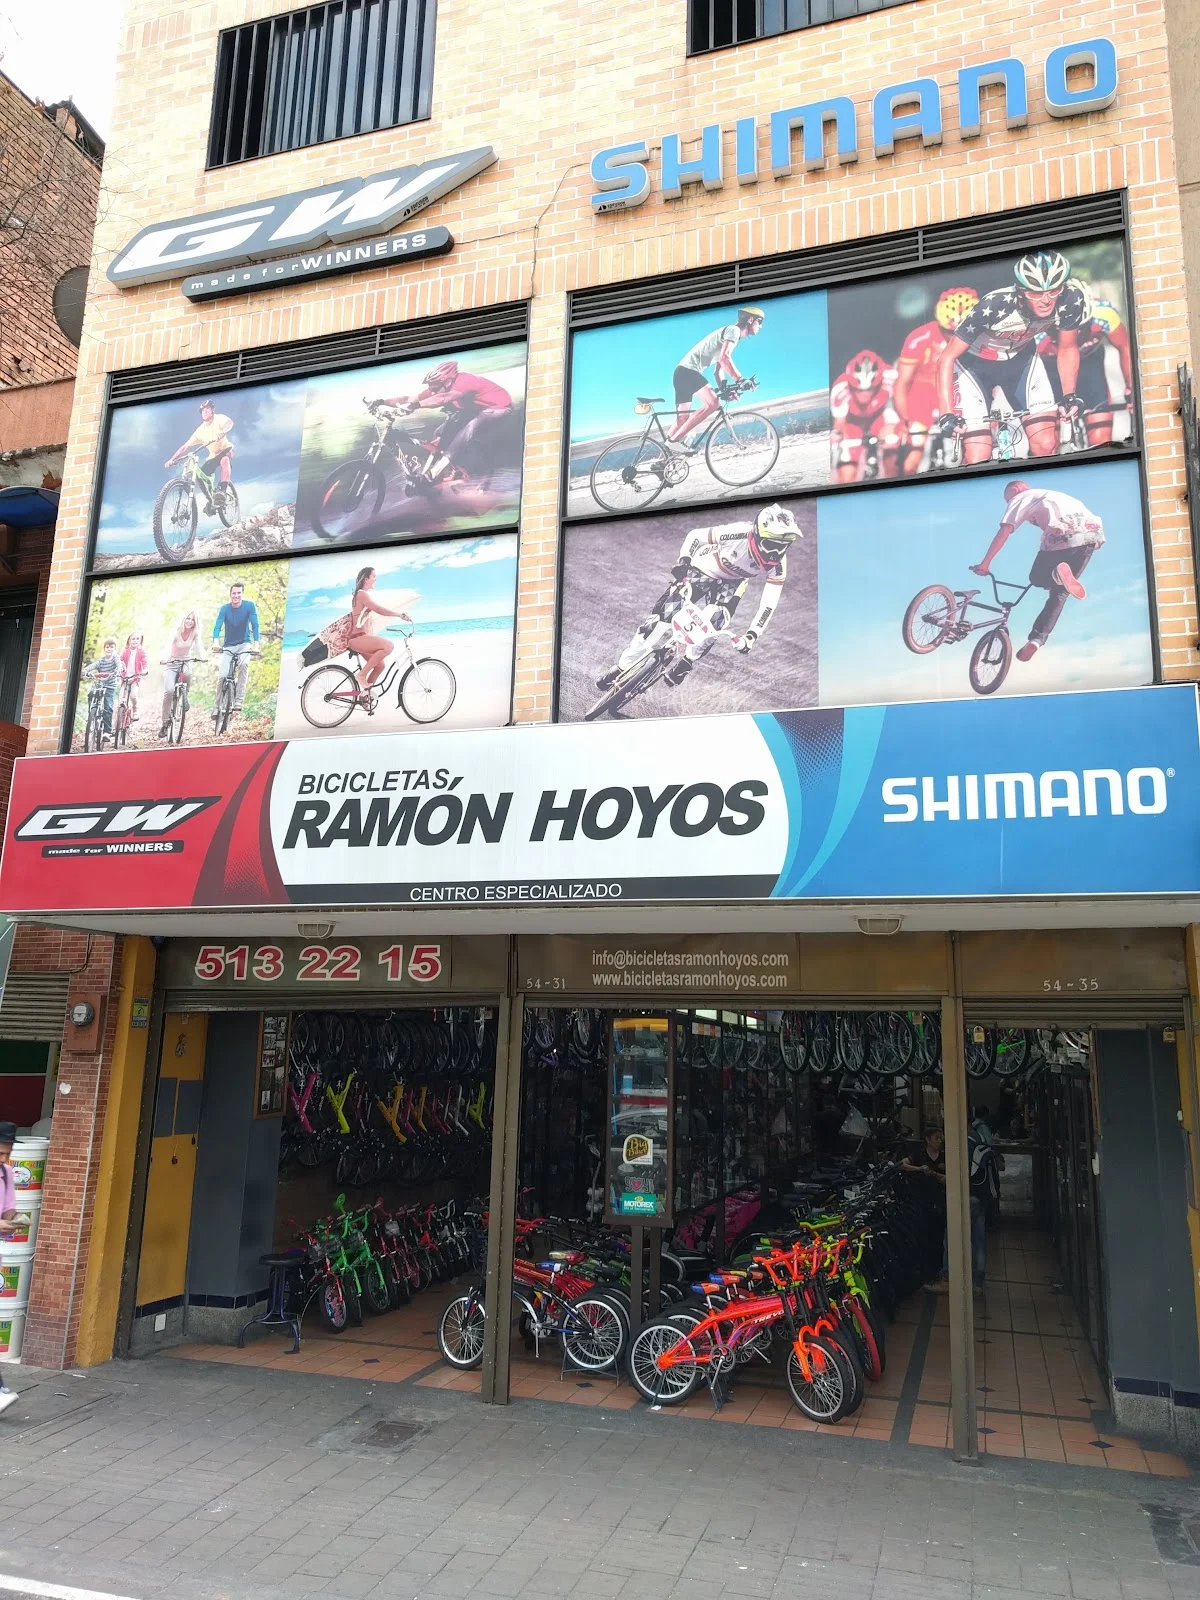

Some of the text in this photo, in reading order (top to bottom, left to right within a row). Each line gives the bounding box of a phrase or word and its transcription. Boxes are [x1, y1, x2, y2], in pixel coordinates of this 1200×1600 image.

[590, 37, 1118, 206] SHIMANO
[113, 161, 462, 274] GW
[190, 272, 251, 290] made
[300, 233, 428, 271] WINNERS
[297, 768, 450, 795] BICICLETAS
[17, 802, 206, 837] GW
[282, 776, 769, 849] RAMÓN HOYOS
[84, 847, 104, 855] for
[106, 842, 174, 854] WINNERS
[409, 883, 623, 901] CENTRO ESPECIALIZADO
[195, 944, 442, 982] 513 22 15
[592, 949, 789, 970] info@bicicletasramonhoyos.com
[592, 970, 788, 990] www.bicicletasramonhoyos.com
